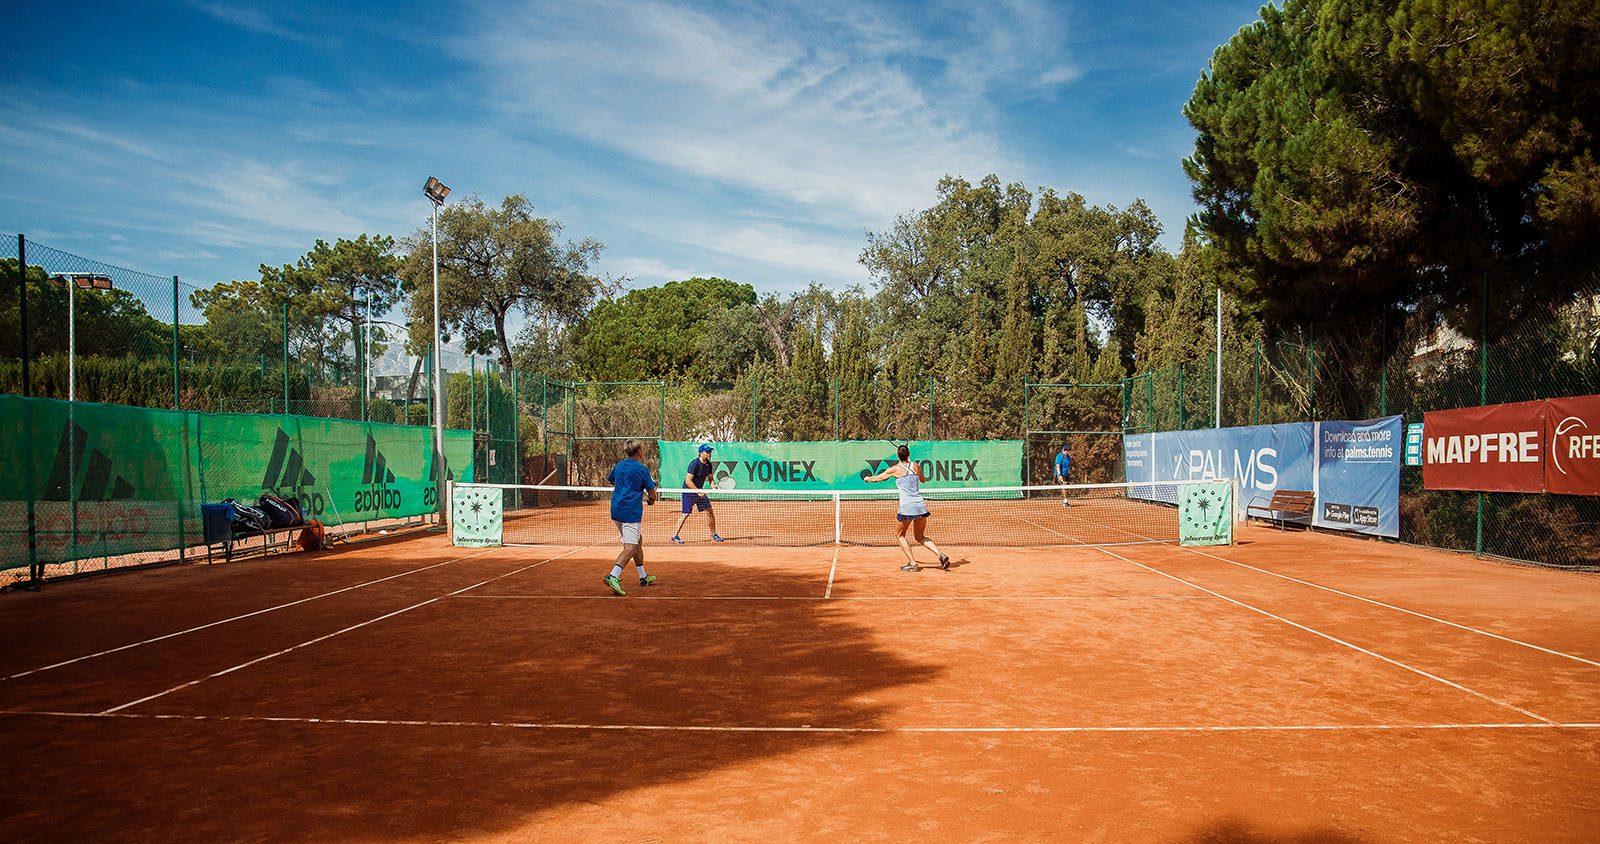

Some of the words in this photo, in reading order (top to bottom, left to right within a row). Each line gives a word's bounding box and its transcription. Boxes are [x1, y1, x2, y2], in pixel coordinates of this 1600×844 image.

[1324, 430, 1357, 443] Download
[1357, 428, 1371, 442] and
[1371, 430, 1392, 442] more
[1324, 445, 1337, 458] info
[1337, 446, 1344, 458] at
[1344, 445, 1393, 461] palms.tennis
[1427, 431, 1539, 464] MAPFRE
[743, 460, 817, 483] YONEX
[914, 459, 980, 482] ONEX
[1189, 448, 1279, 491] PALMS
